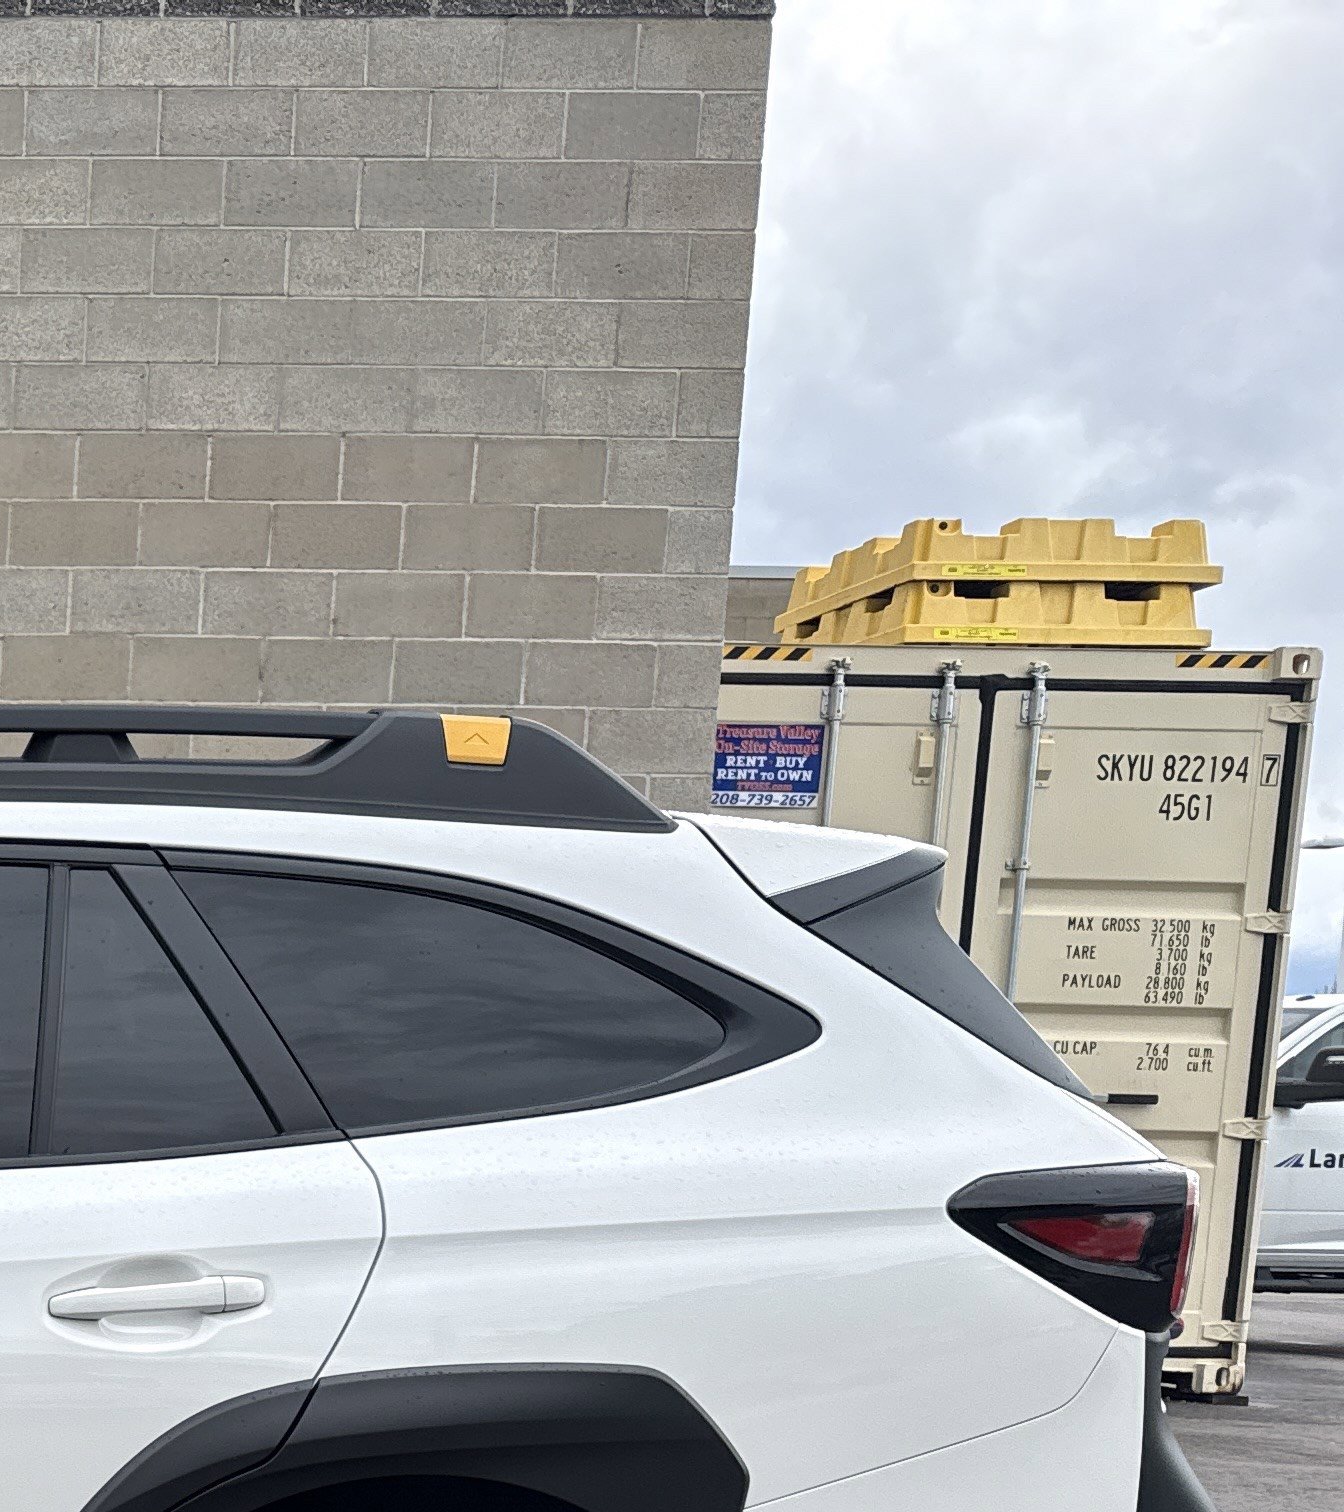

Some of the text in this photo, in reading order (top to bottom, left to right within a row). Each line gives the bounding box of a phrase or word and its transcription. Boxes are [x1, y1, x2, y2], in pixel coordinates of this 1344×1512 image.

[716, 725, 820, 743] Treasure Valley
[715, 739, 819, 757] On-Site Storage
[724, 755, 808, 769] RENT BUY
[1096, 753, 1279, 784] SKYU 822194 7
[715, 768, 758, 781] RENT
[777, 769, 814, 782] OWN
[711, 793, 817, 807] 208-739-2657
[1158, 793, 1213, 822] 45G1
[1067, 917, 1094, 932] MAX
[1101, 917, 1141, 933] GROSS
[1201, 921, 1216, 938] kg
[1066, 945, 1096, 960] TARE
[1199, 950, 1213, 966] kg
[1061, 973, 1122, 989] PAYLOAD
[1195, 979, 1210, 995] kg
